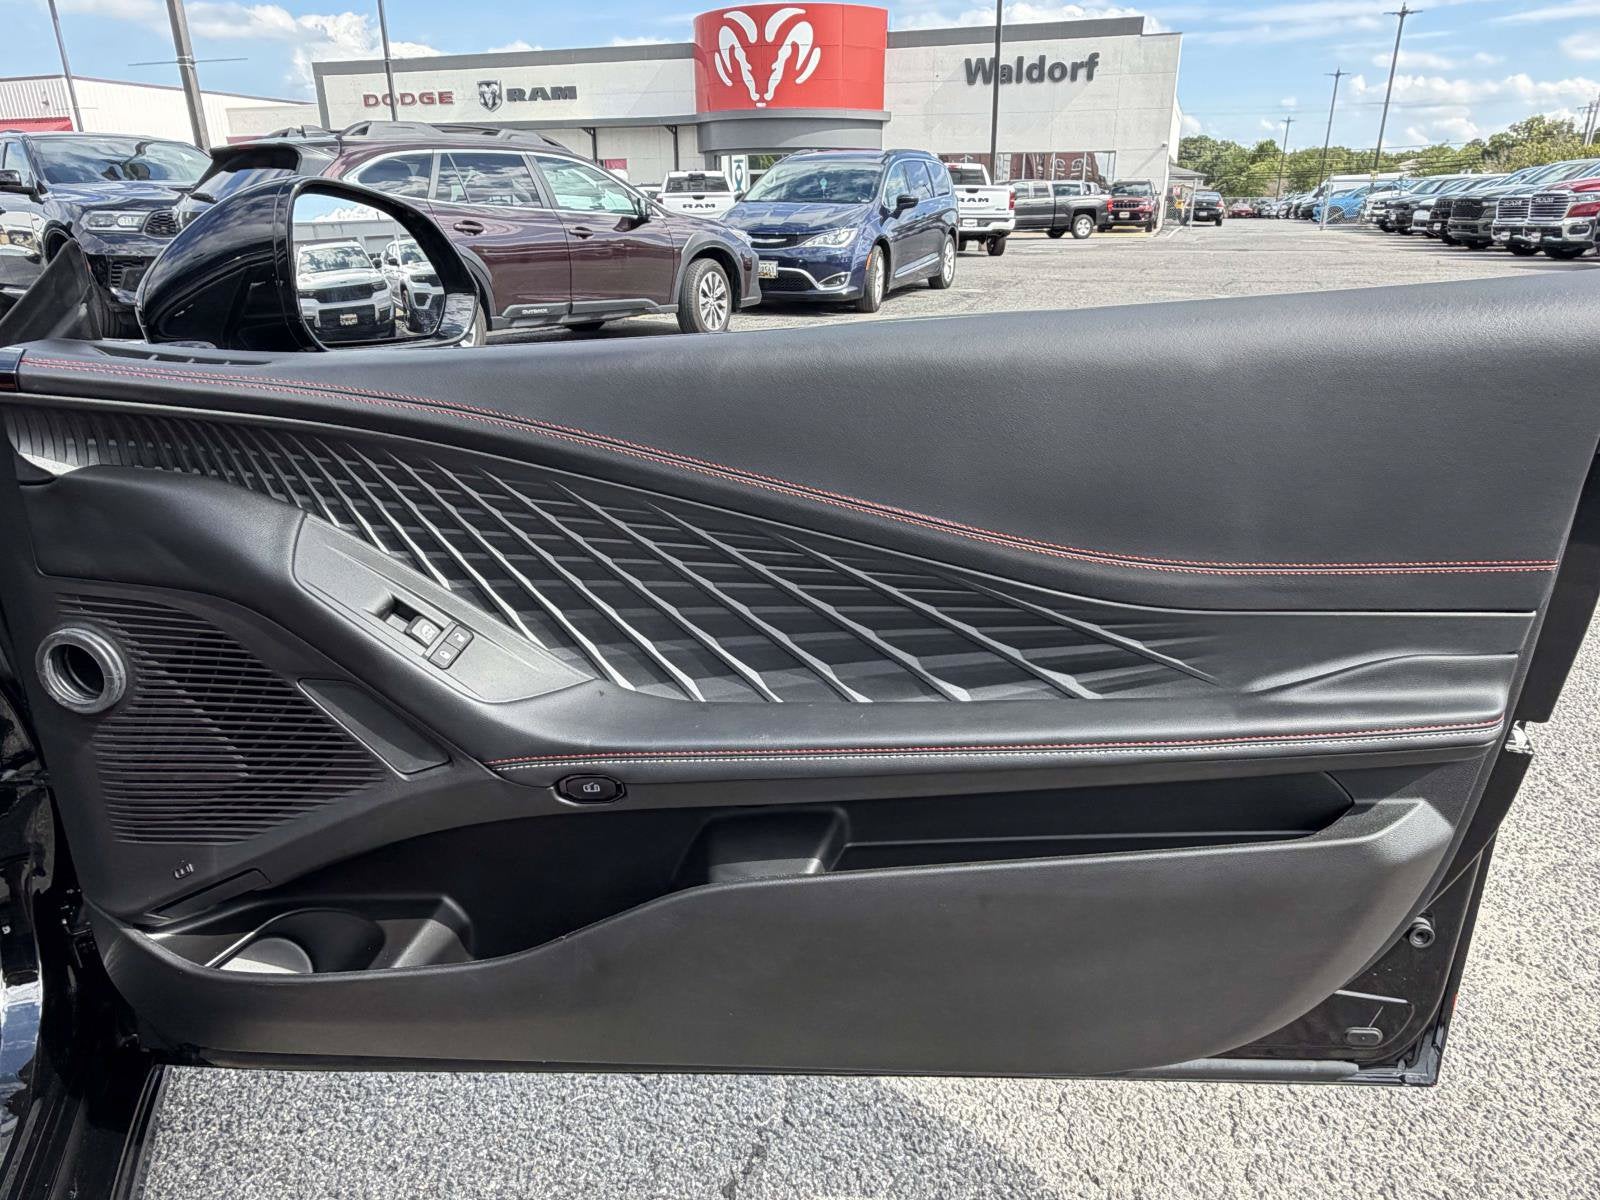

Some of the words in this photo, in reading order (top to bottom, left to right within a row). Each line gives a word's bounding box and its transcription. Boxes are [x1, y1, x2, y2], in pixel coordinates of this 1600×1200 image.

[964, 52, 1100, 85] Waldorf
[363, 91, 454, 107] DODGE
[506, 86, 578, 102] RAM
